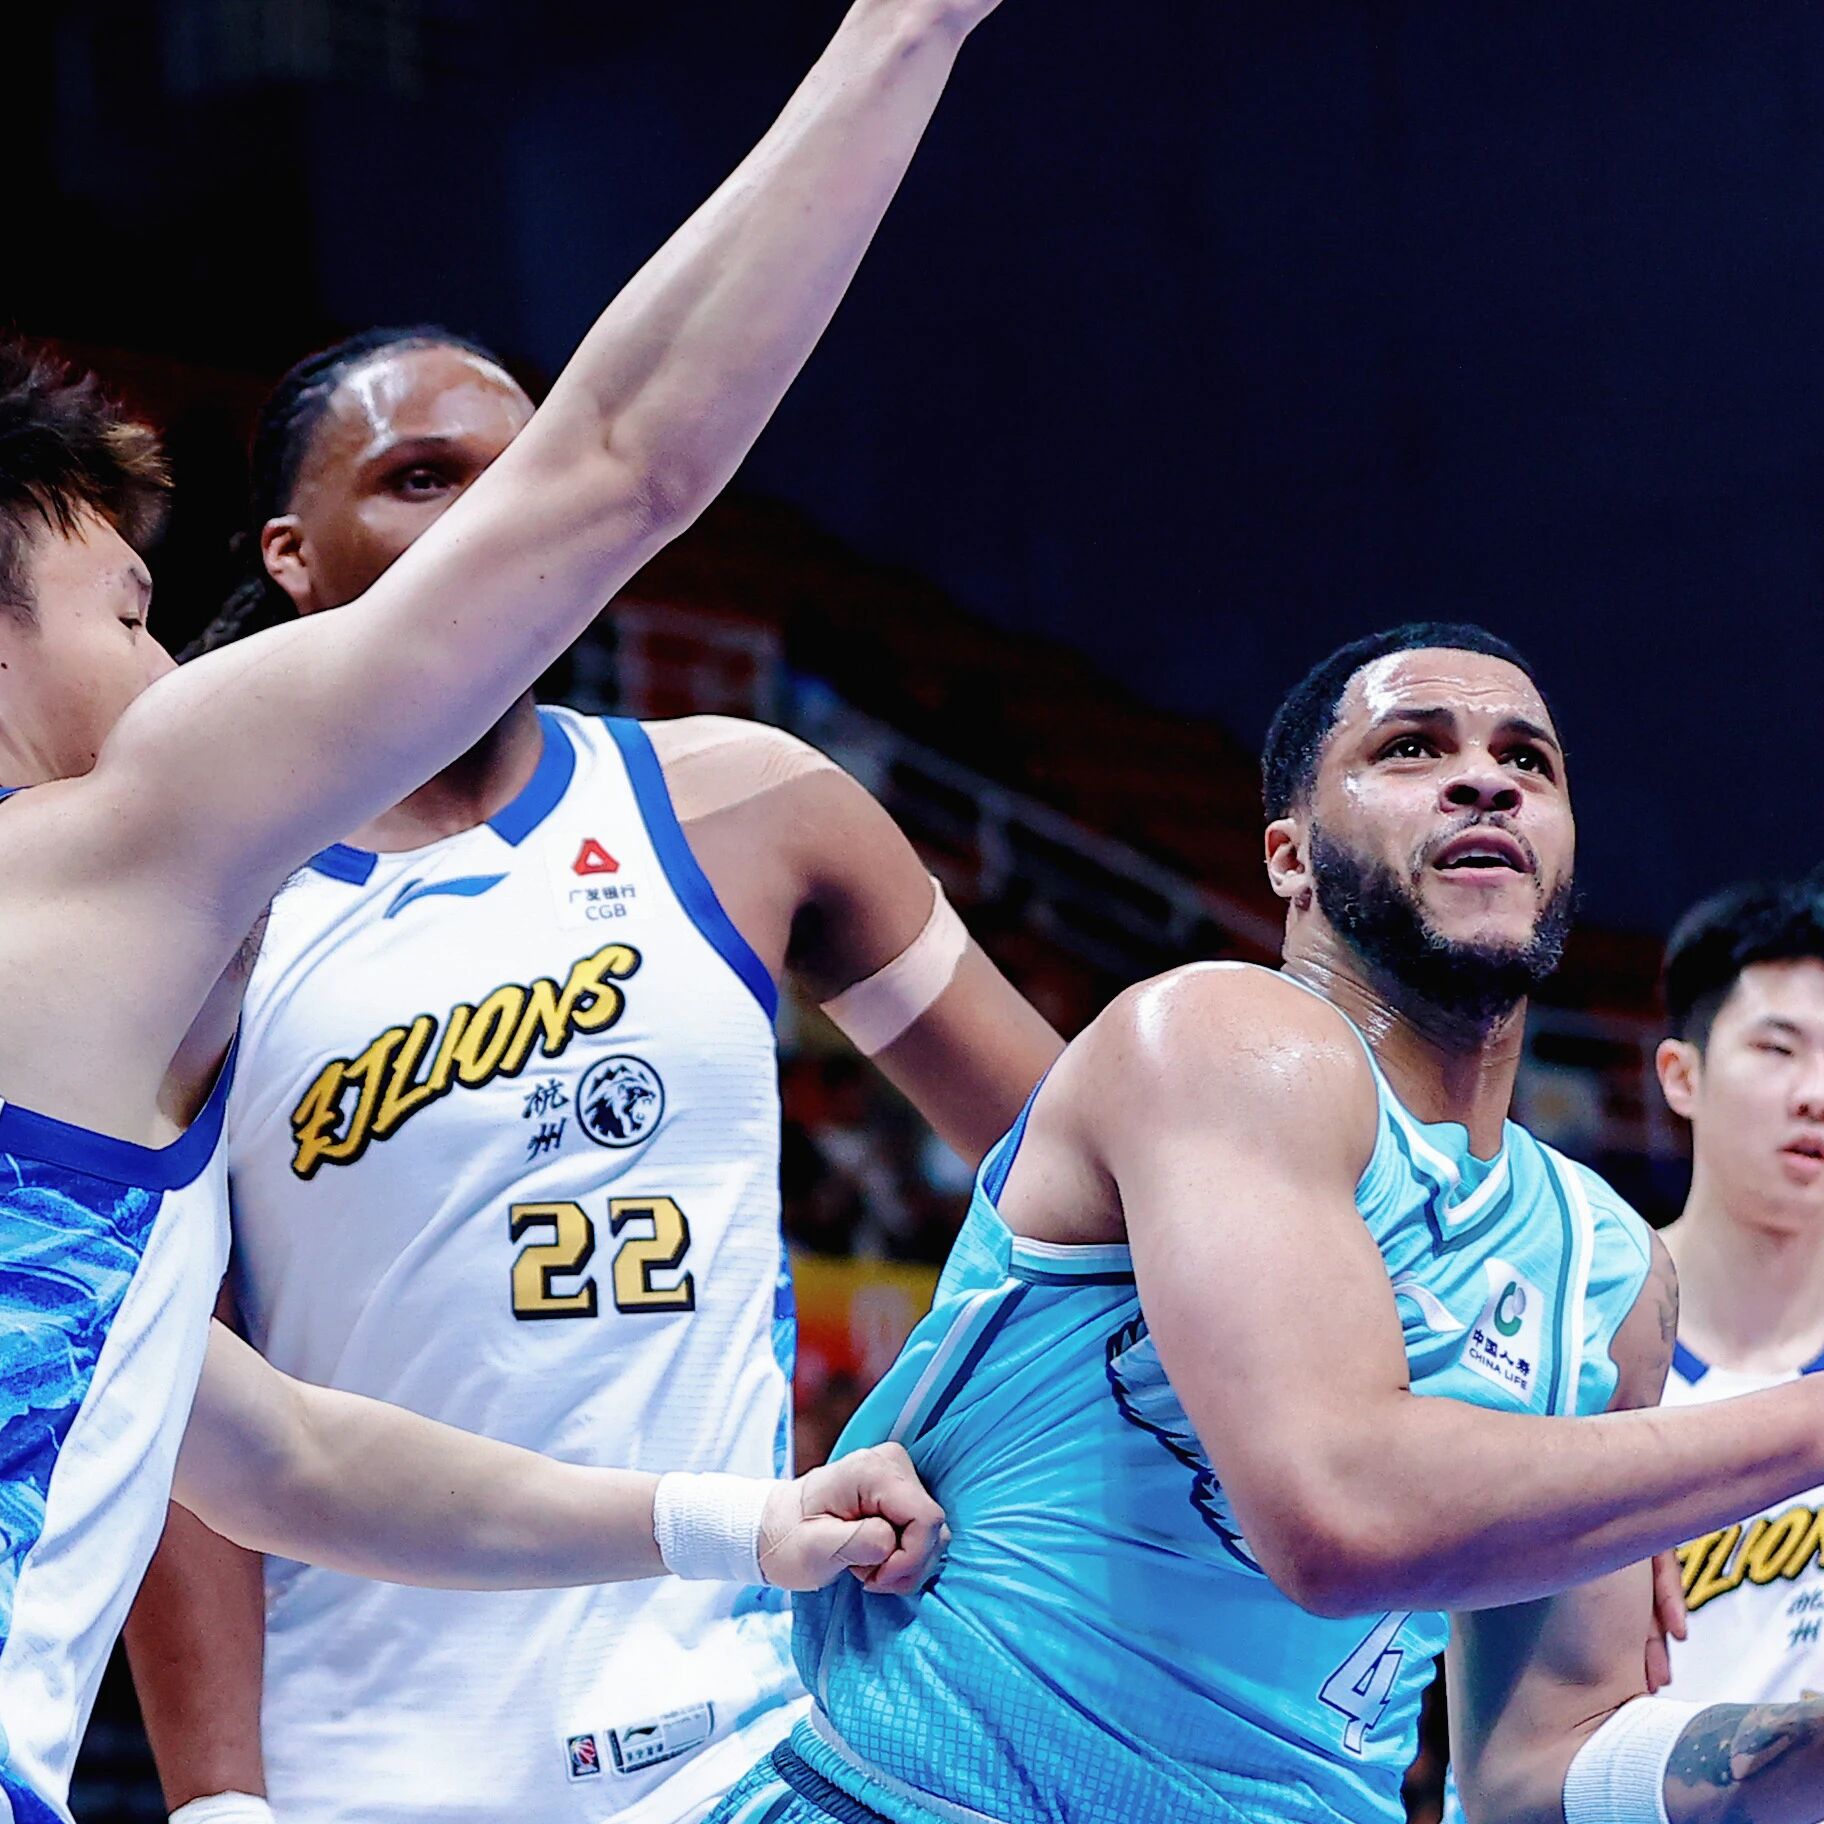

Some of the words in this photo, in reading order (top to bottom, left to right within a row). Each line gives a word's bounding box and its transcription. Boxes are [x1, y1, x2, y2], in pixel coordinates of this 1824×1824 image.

[585, 903, 627, 921] CGB
[509, 1196, 696, 1321] 22
[1468, 1347, 1502, 1375] CHINA
[1504, 1369, 1529, 1391] LIFE
[1472, 1328, 1531, 1377] 中国人寿
[1318, 1610, 1405, 1754] 4
